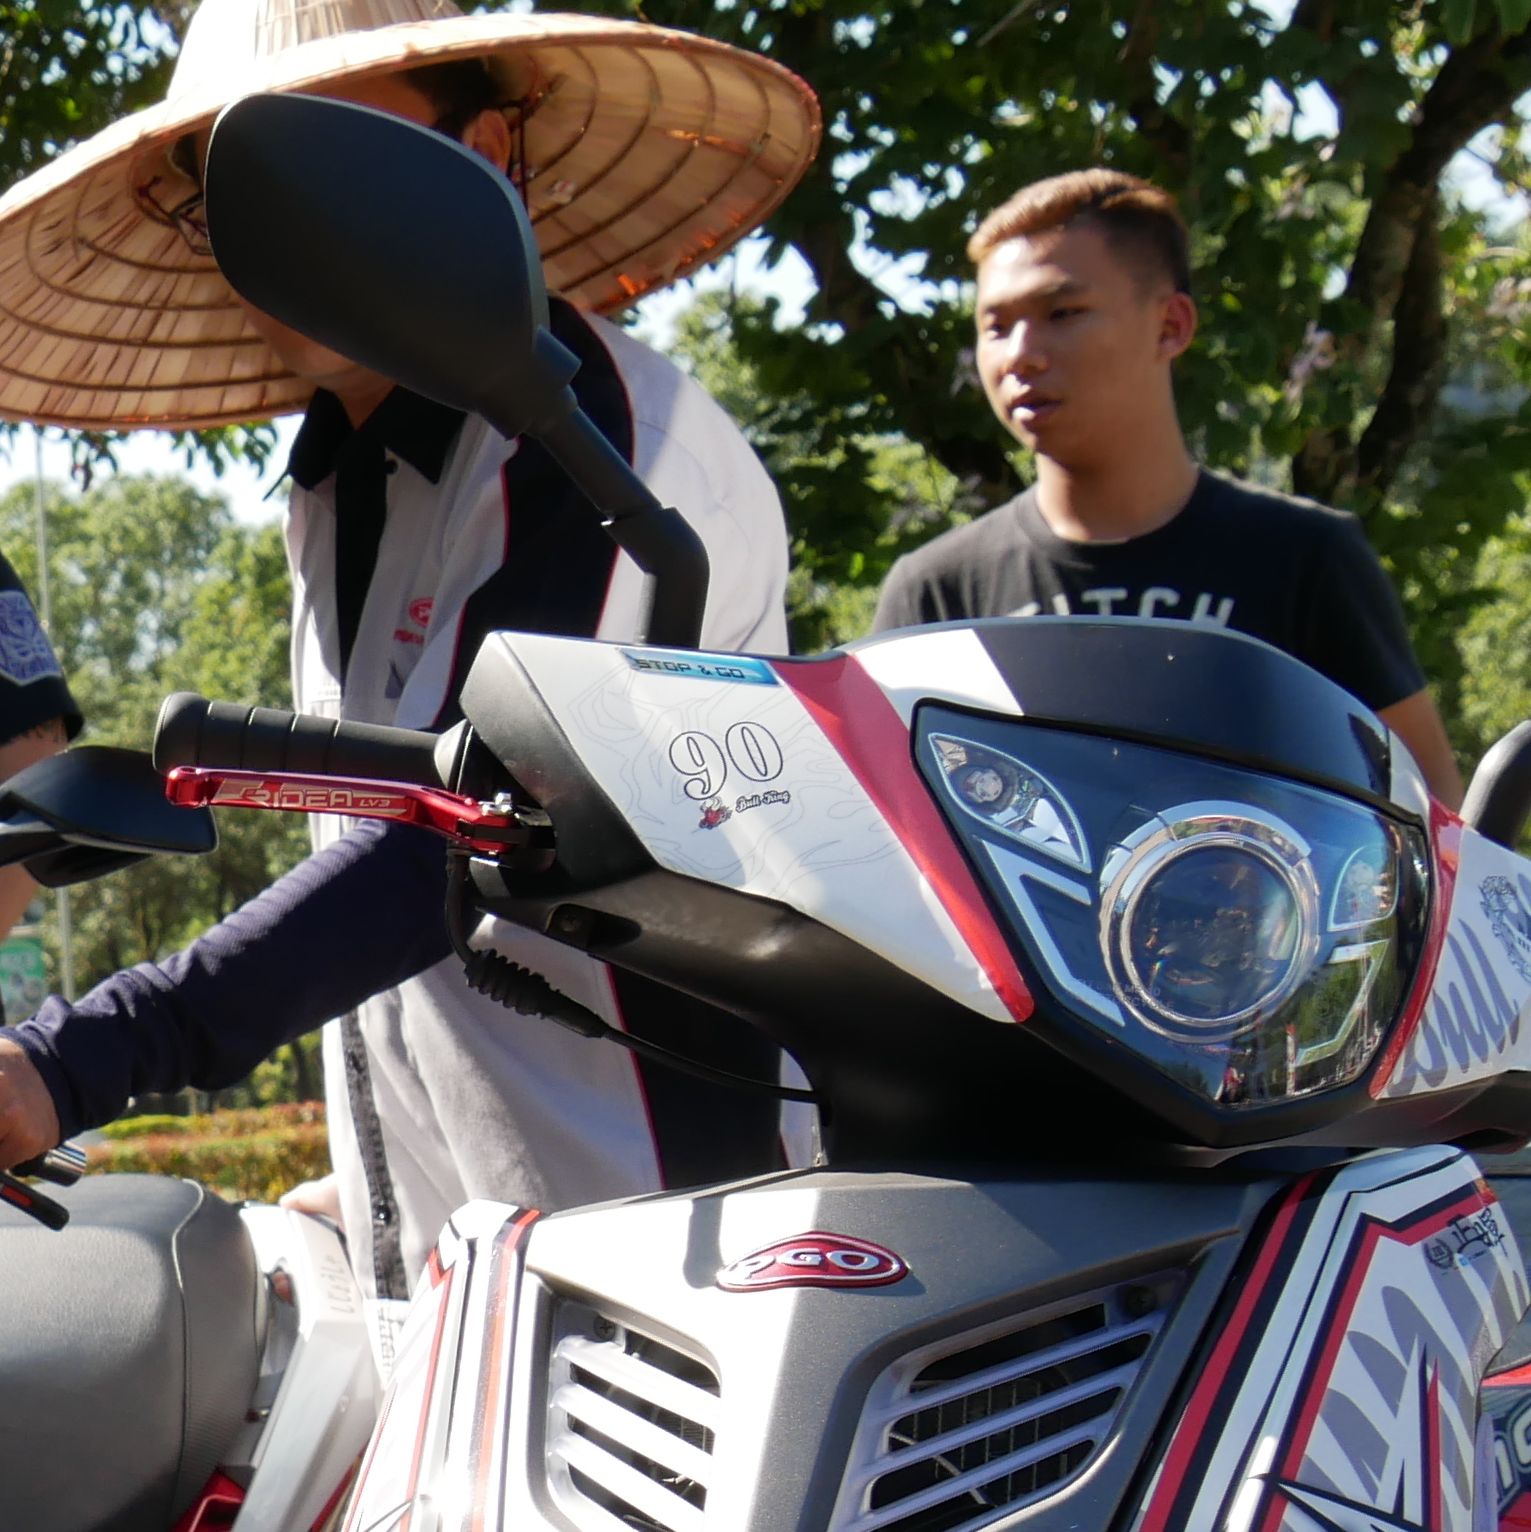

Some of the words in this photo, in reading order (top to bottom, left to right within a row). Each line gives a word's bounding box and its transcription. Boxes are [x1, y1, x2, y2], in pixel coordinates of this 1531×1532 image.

[637, 658, 692, 673] STOP
[698, 664, 713, 676] &
[715, 667, 746, 679] GO
[668, 720, 784, 801] 90
[731, 1247, 881, 1281] PGO
